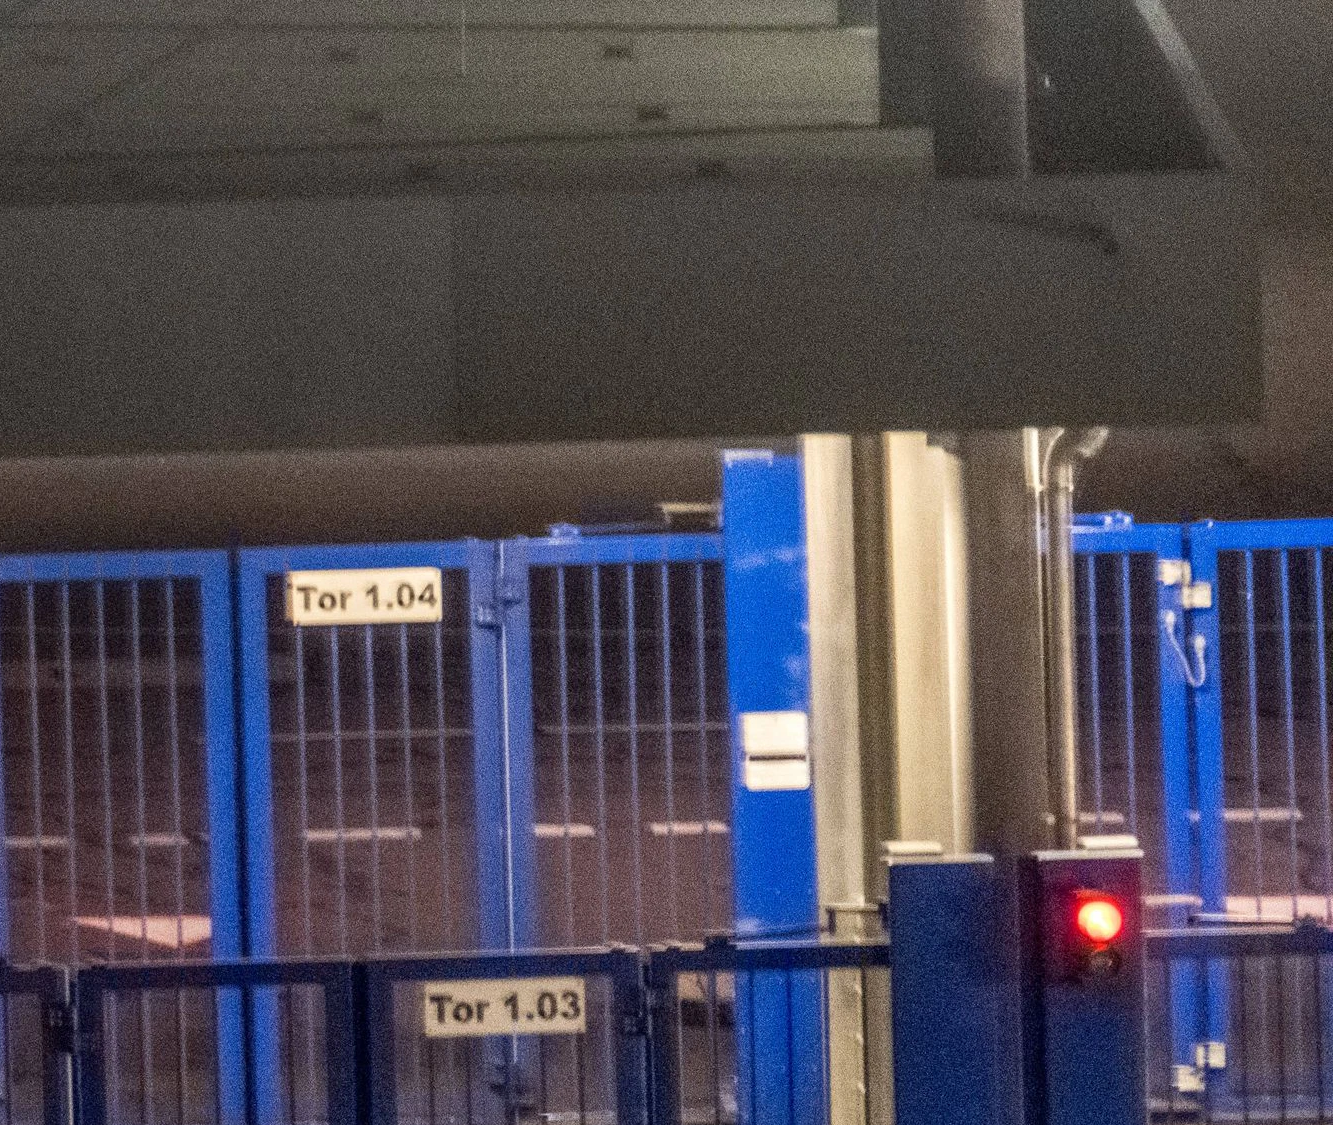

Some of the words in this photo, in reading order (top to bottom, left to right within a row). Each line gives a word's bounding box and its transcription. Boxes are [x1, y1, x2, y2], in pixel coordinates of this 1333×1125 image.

[296, 584, 352, 612] Tor
[365, 582, 438, 610] 1.04
[429, 993, 490, 1024] Tor
[503, 990, 581, 1021] 1.03
